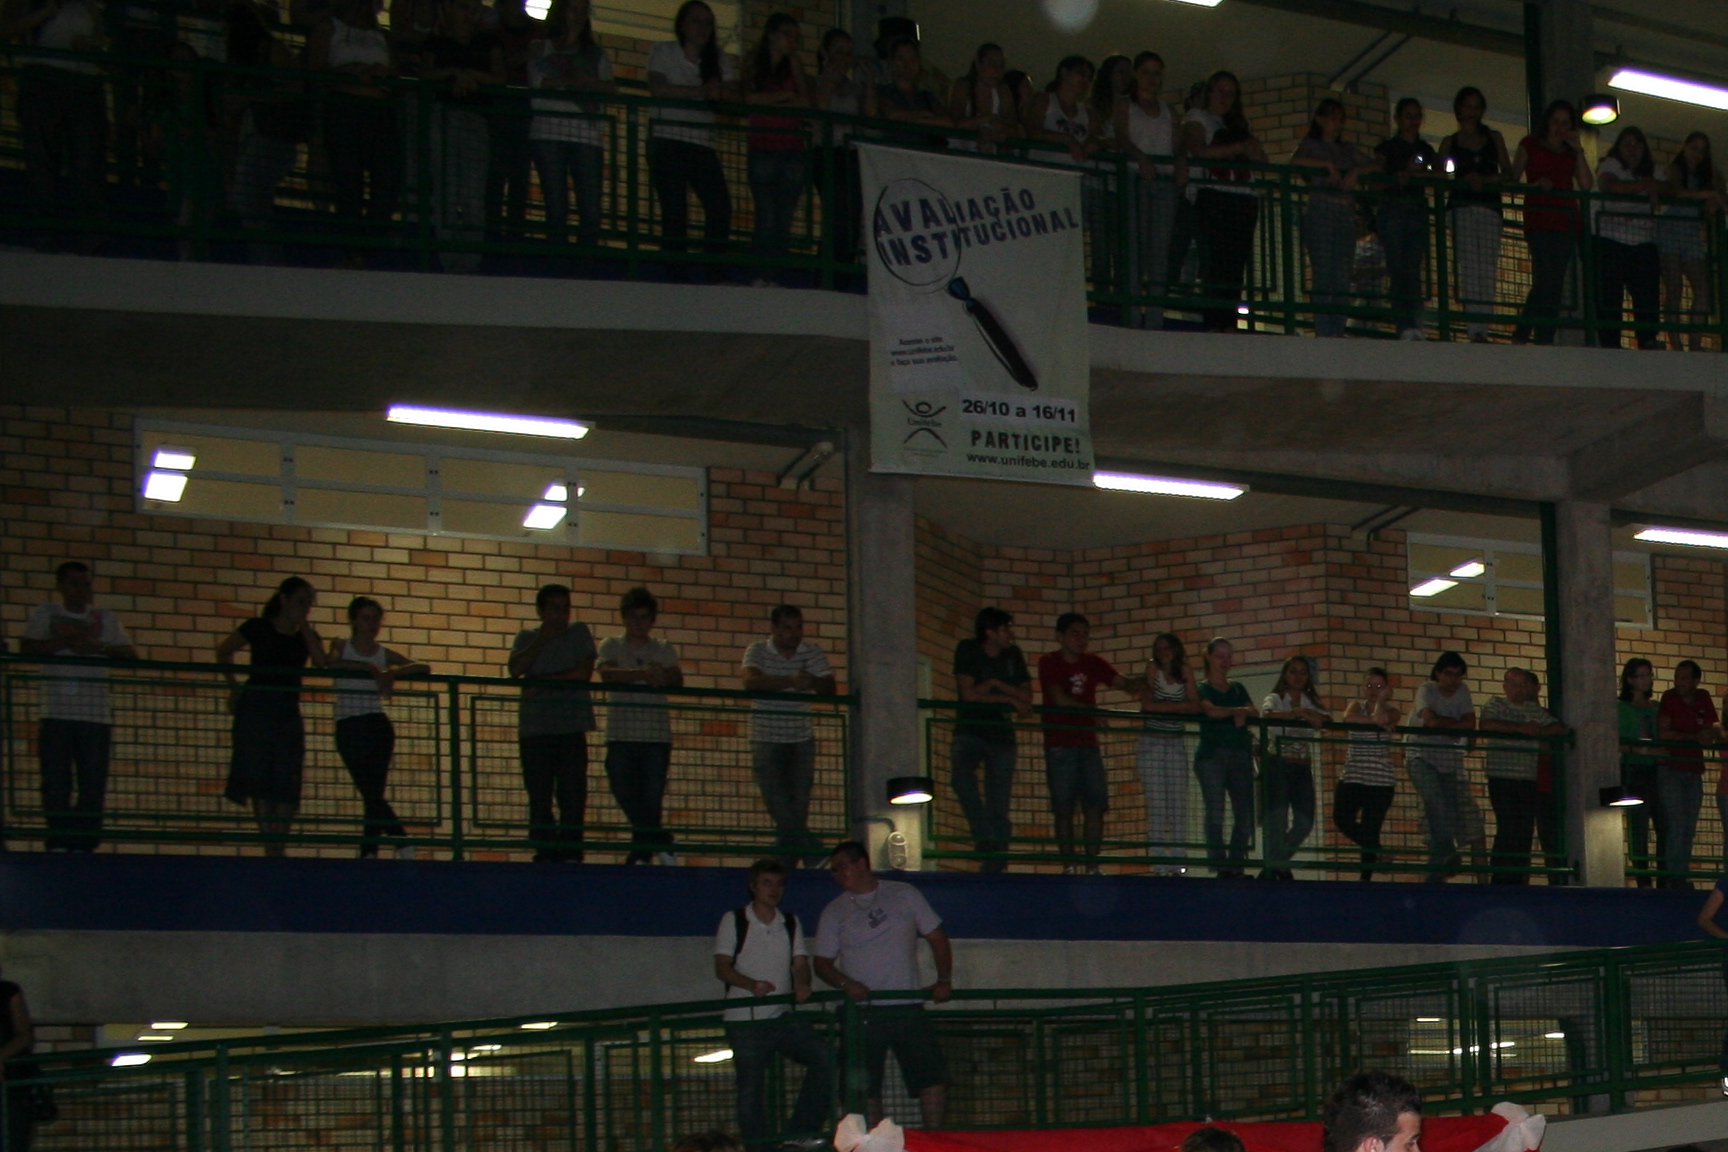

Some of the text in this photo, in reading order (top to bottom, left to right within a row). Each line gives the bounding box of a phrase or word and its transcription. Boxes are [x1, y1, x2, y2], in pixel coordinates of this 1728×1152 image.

[875, 188, 1034, 237] AVALIAÇÃO
[879, 207, 1079, 265] INSTITUCIONAL
[962, 399, 1075, 422] 26/10 a 16/11
[971, 430, 1080, 453] PARTICIPE!
[967, 453, 1090, 470] www.unifebe.edu.br
